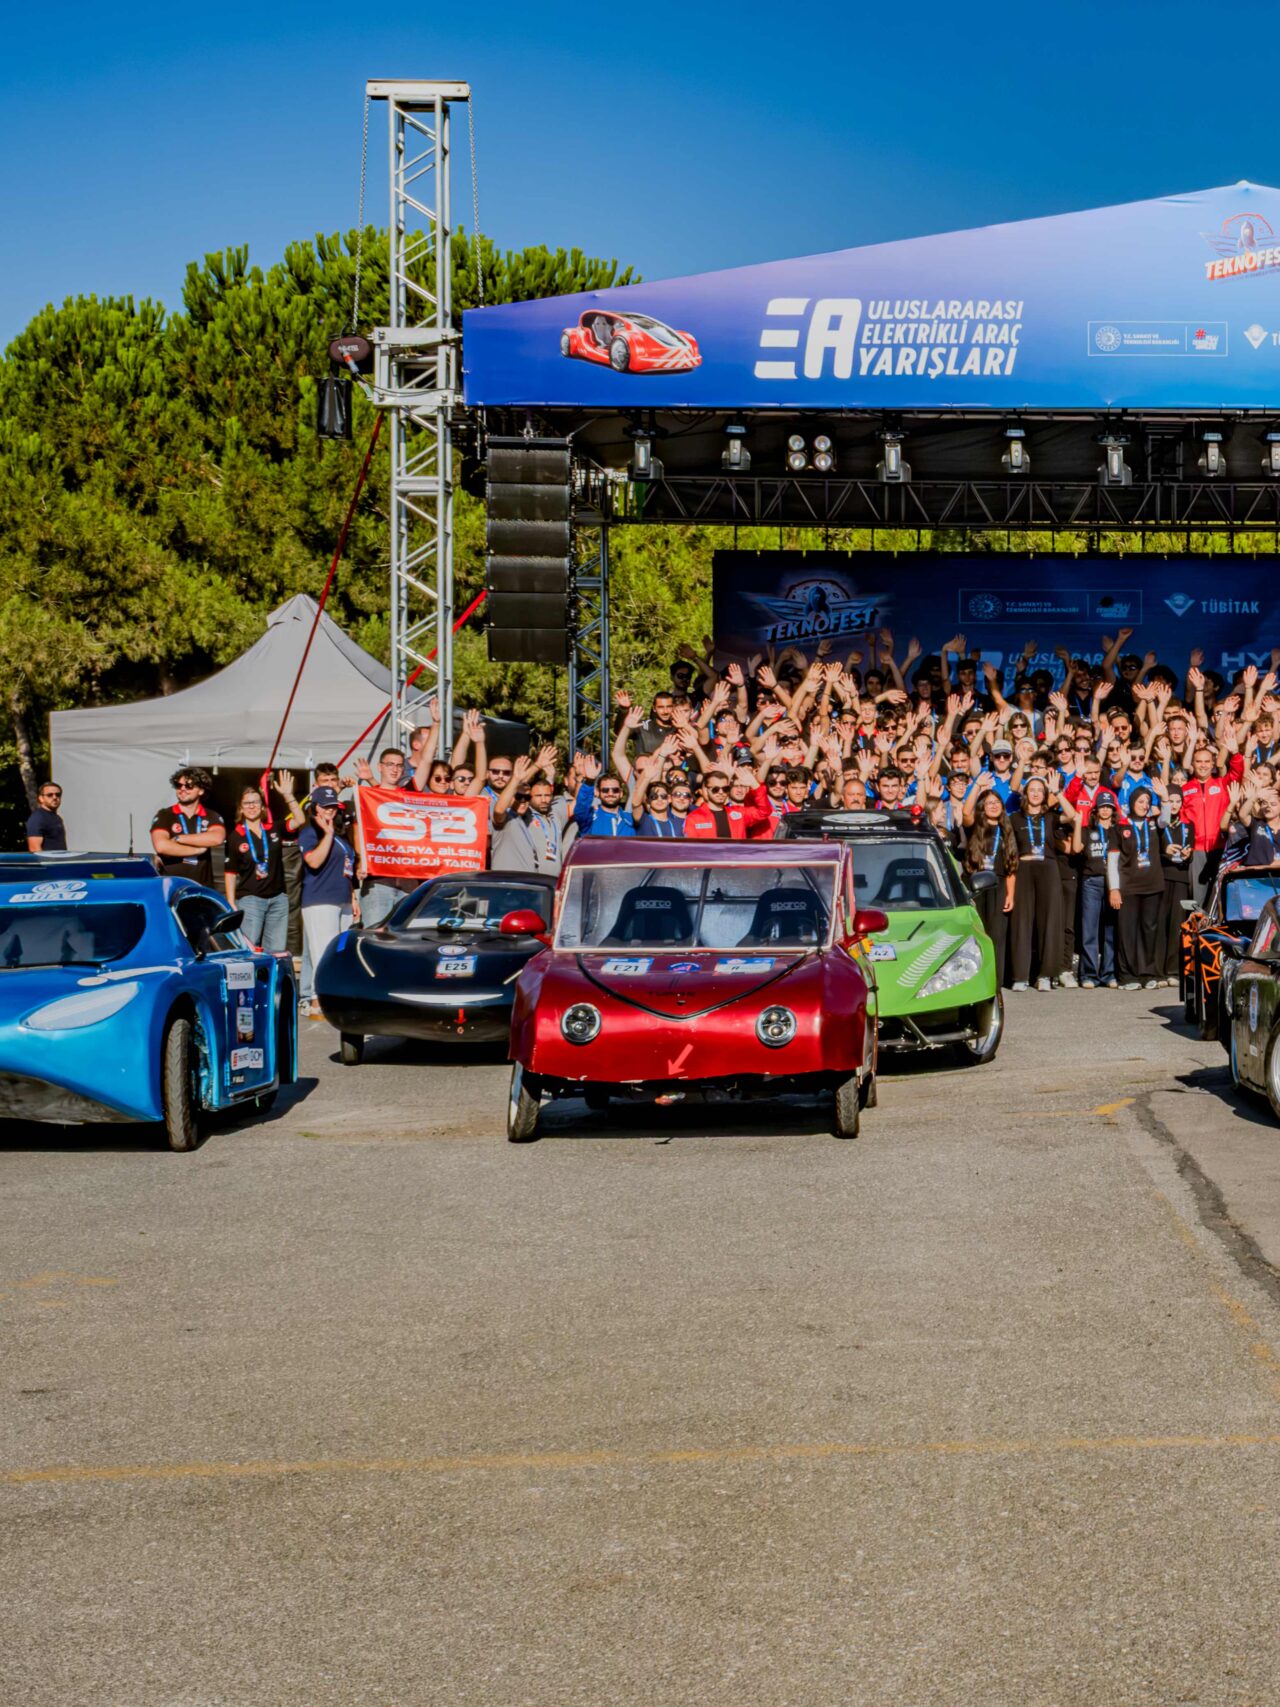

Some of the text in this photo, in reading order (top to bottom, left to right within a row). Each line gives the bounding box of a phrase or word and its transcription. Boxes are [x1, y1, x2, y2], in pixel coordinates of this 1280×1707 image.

[868, 300, 1024, 320] ULUSLARARASI
[861, 320, 1022, 347] ELEKTRİKLİ ARAÇ
[859, 347, 1018, 379] YARIŞLARI
[1201, 598, 1259, 614] TÜBİTAK
[765, 607, 878, 643] TEKNOFEST
[376, 802, 478, 844] SB
[366, 843, 435, 855] SAKARYA
[367, 855, 440, 867] TEKNOLOJİ
[635, 900, 671, 909] sparco
[770, 901, 807, 911] sparco
[445, 963, 468, 971] E25
[613, 964, 639, 972] E21
